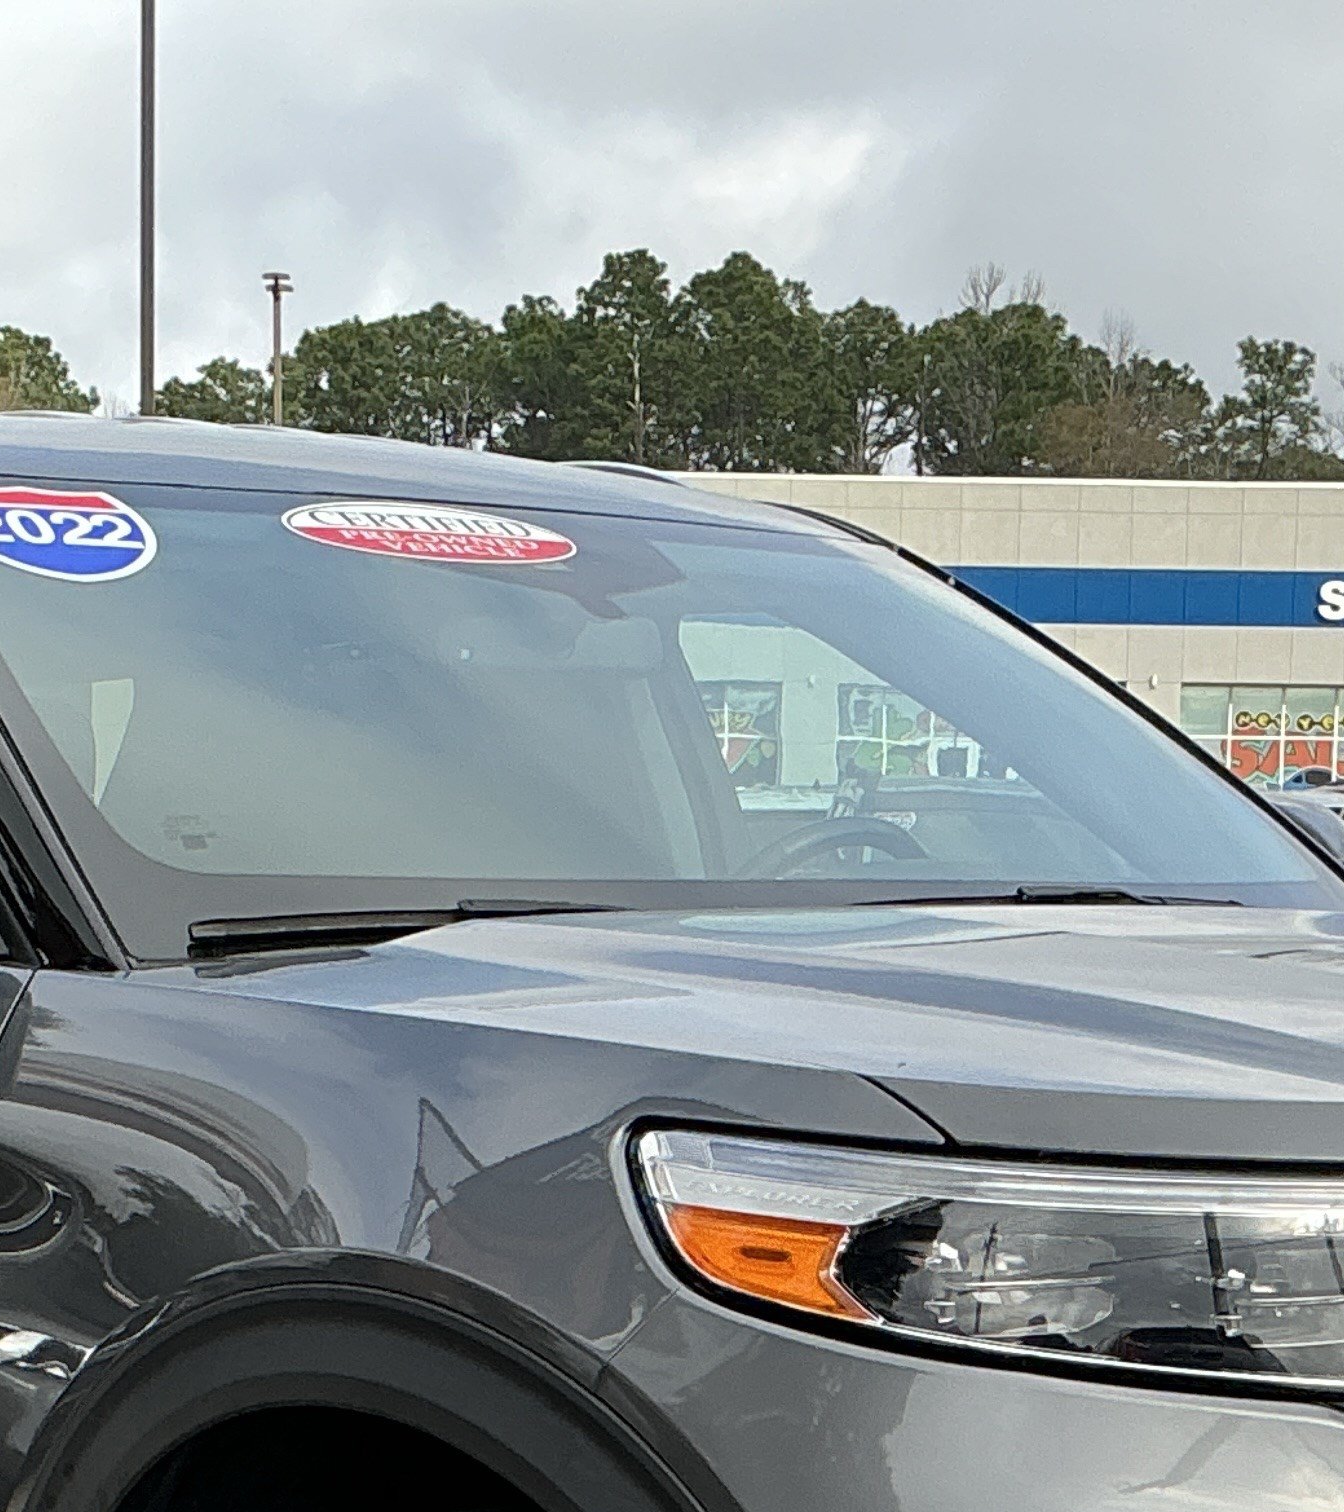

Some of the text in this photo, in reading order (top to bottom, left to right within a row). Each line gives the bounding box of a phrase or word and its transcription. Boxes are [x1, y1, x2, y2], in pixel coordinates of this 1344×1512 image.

[308, 510, 531, 537] CERTIFIED
[338, 529, 539, 550] PRE-OWNED
[379, 539, 526, 558] VEHICLE
